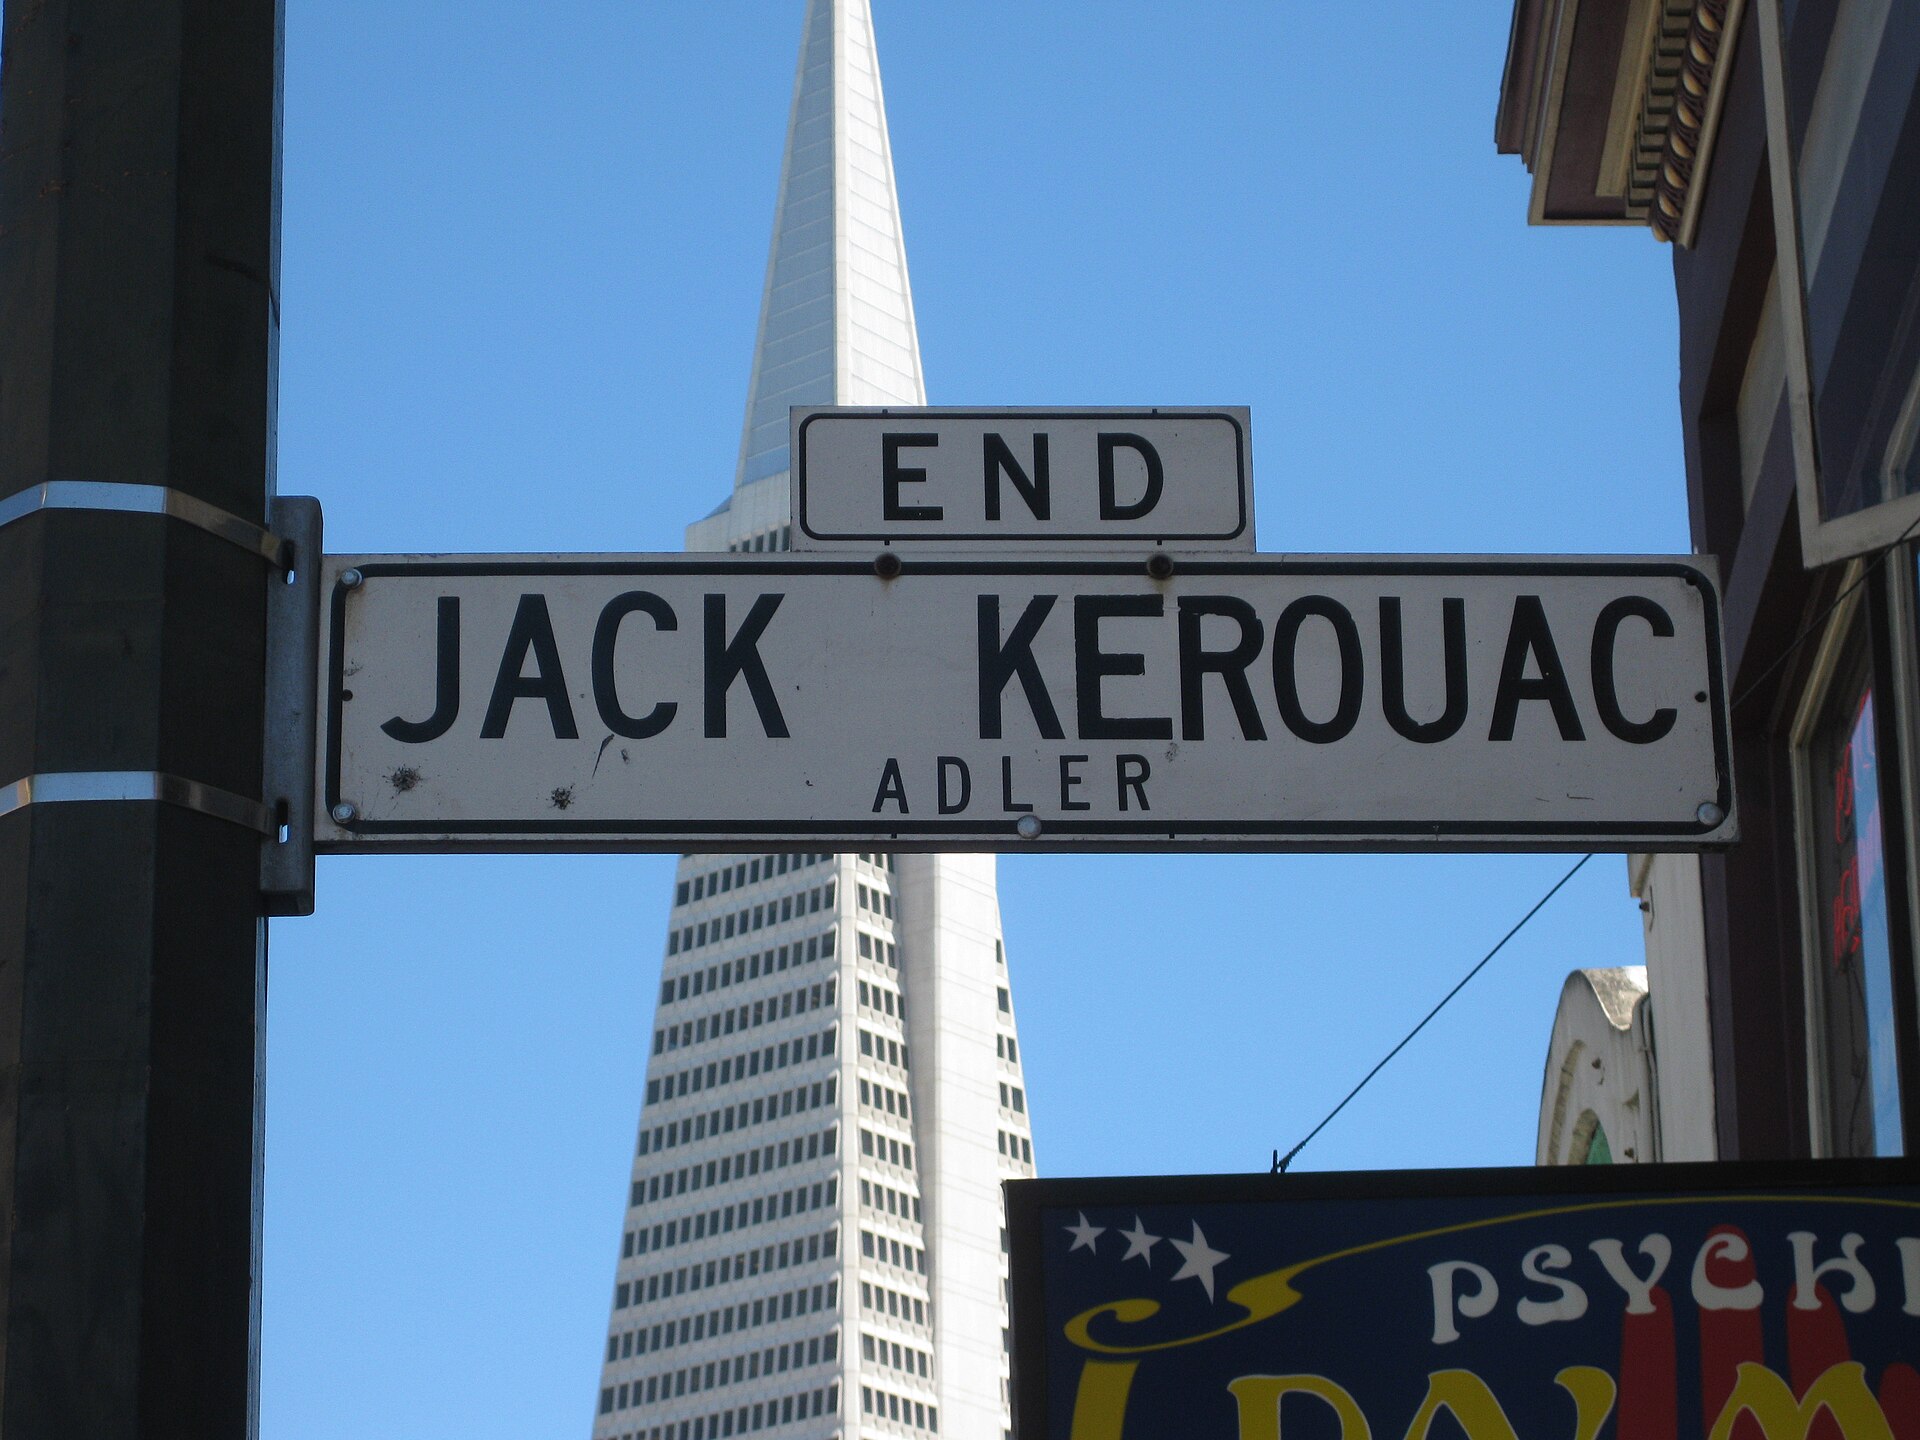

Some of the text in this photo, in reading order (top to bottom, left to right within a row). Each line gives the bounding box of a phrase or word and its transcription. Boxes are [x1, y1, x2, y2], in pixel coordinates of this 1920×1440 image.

[882, 433, 1164, 521] END
[380, 590, 1677, 744] JACK KEROUAC
[872, 754, 1151, 814] ADLER
